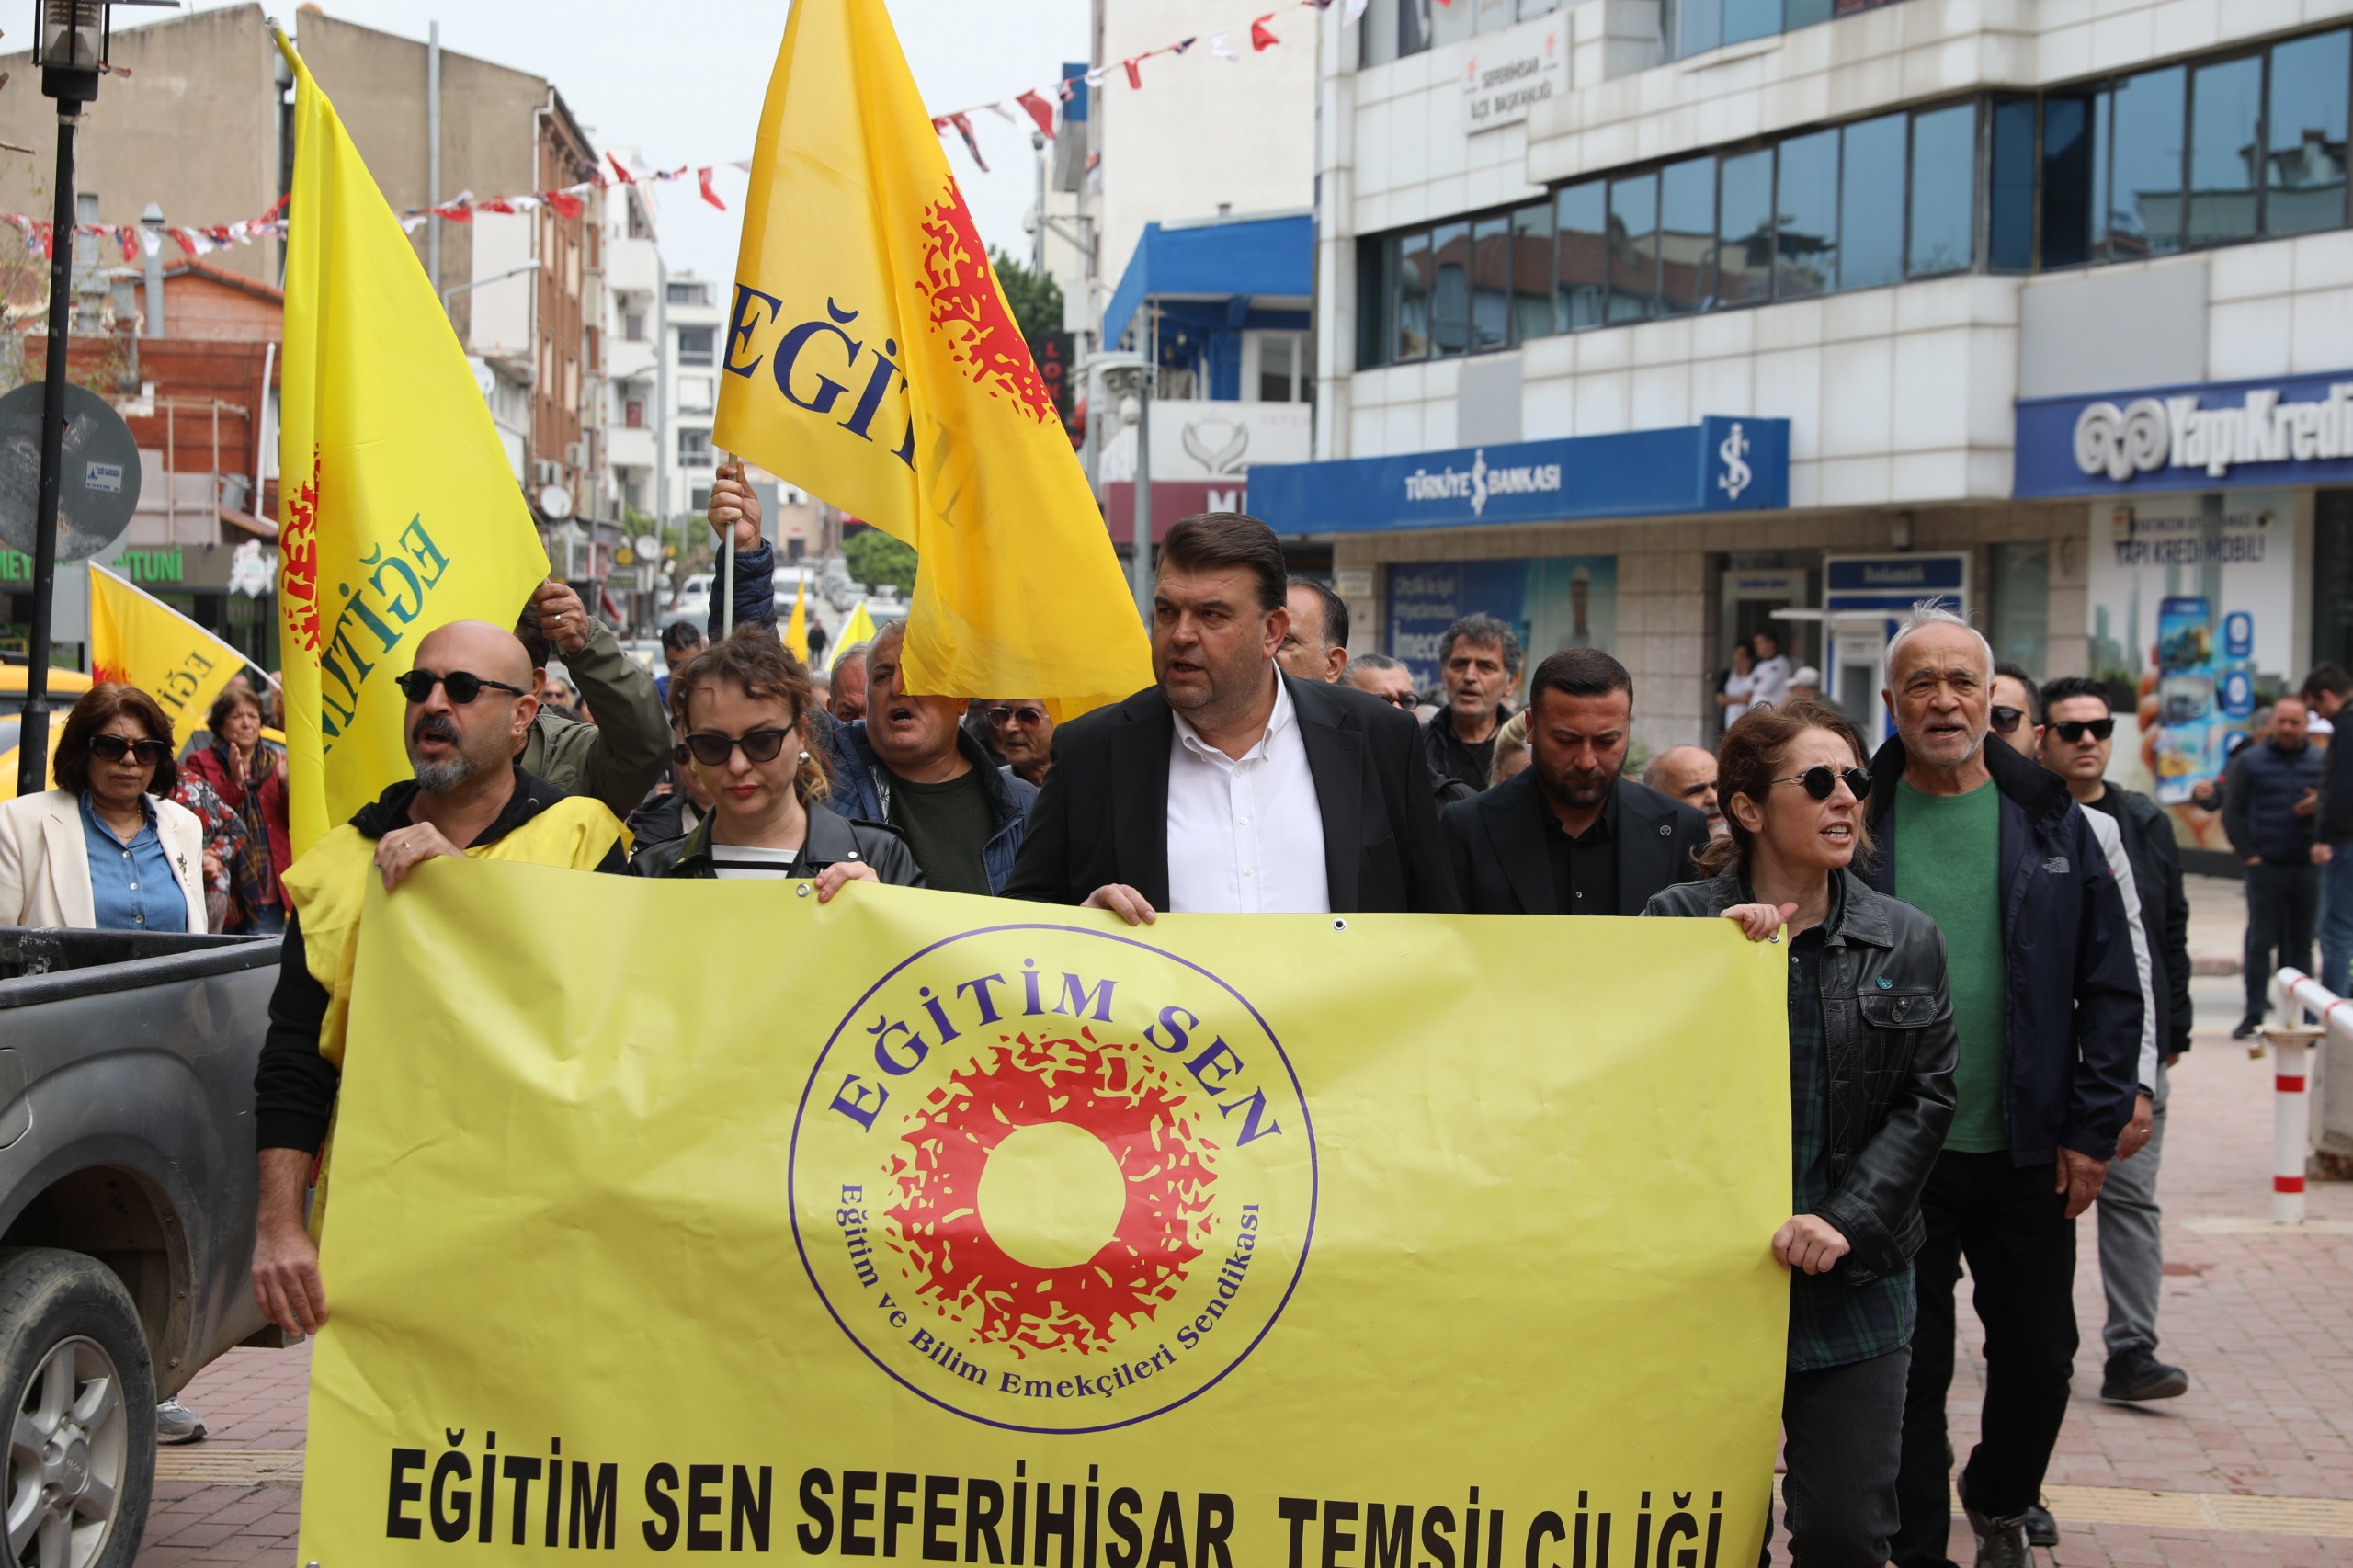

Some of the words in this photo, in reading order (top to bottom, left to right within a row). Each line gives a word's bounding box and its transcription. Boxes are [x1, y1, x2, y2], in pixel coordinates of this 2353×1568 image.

[1404, 466, 1471, 501] TÜRKİYE
[1488, 464, 1561, 495] BANKASI
[828, 957, 1119, 1133] EĞİTİM
[1143, 1005, 1283, 1147] SEN
[835, 1183, 880, 1289] Eğitim
[879, 1291, 908, 1329] ve
[908, 1328, 988, 1386] Bilim
[999, 1343, 1176, 1398] Emekçileri
[1176, 1203, 1260, 1351] Sendikası
[386, 1427, 618, 1551] EĞİTİM
[642, 1461, 772, 1553] SEN
[797, 1459, 1234, 1568] SEFERİHİSAR
